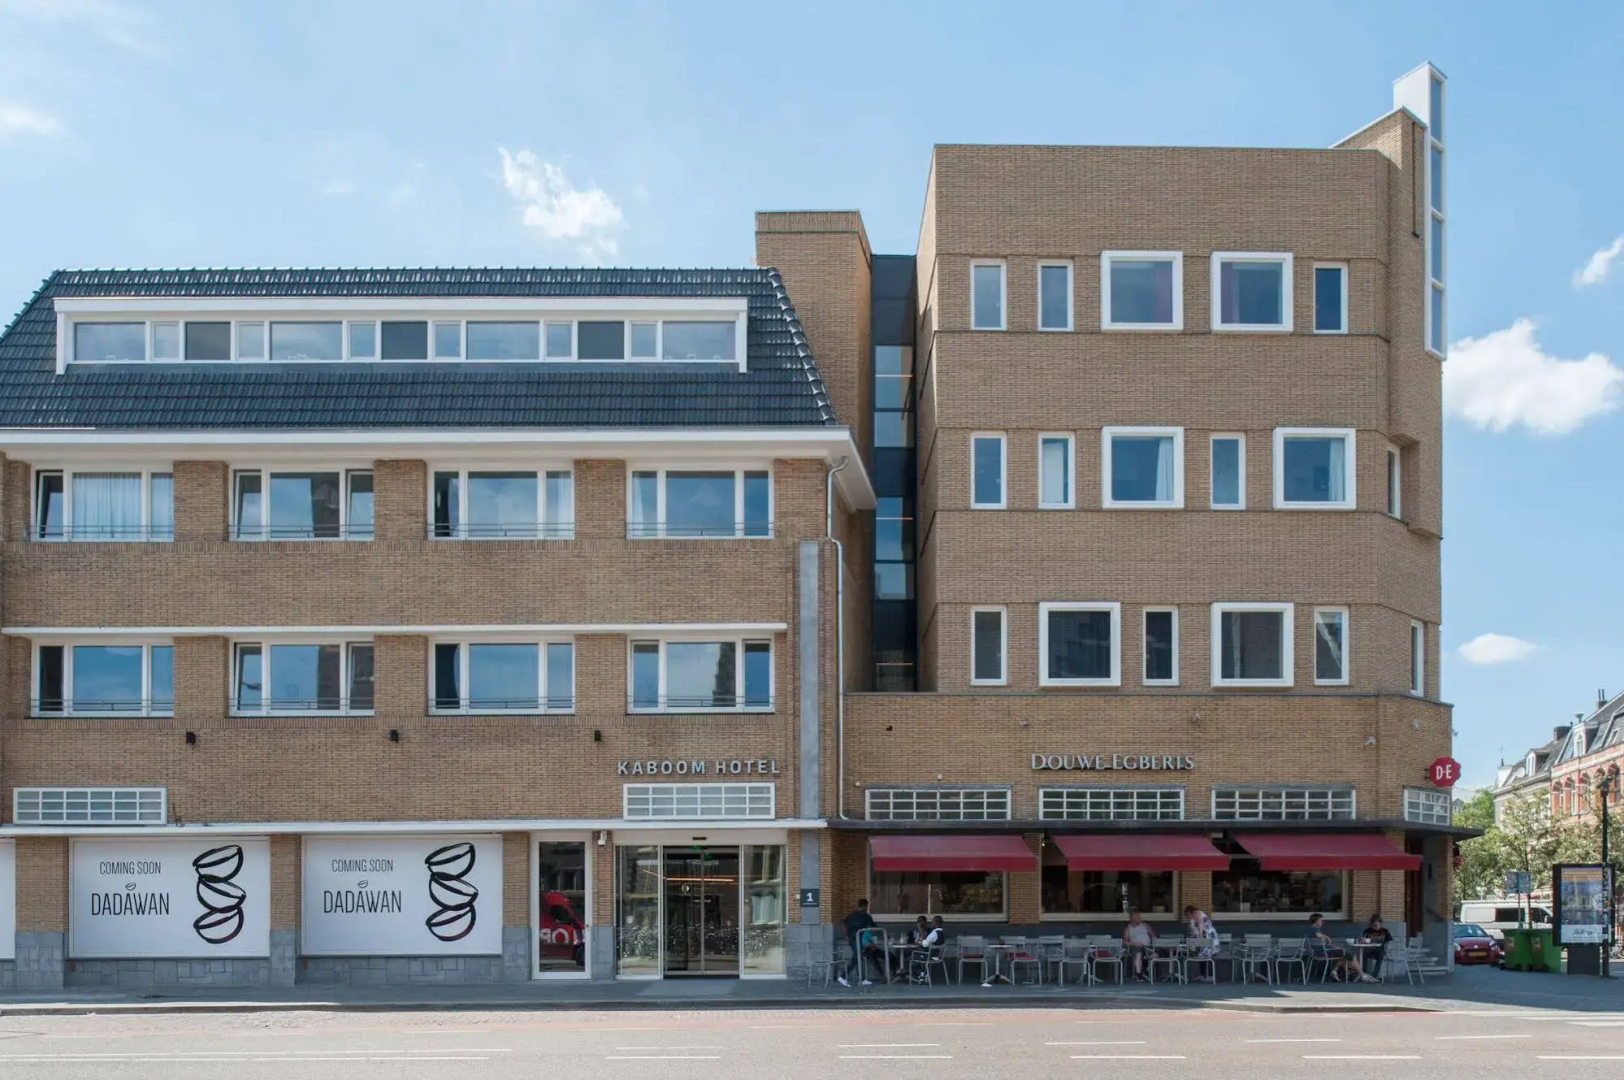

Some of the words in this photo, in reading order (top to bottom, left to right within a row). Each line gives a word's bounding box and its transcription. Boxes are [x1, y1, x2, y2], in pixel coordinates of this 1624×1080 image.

[617, 760, 706, 775] KABOOM
[715, 760, 780, 774] HOTEL
[1031, 753, 1105, 770] DOUWE
[1112, 753, 1194, 770] EGBERTS
[99, 861, 135, 875] COMING
[137, 861, 161, 875] SOON
[332, 859, 367, 872] COMING
[369, 859, 394, 872] SOON
[91, 892, 170, 916] DADAWAN
[323, 890, 402, 913] DADAWAN
[806, 892, 814, 902] 1
